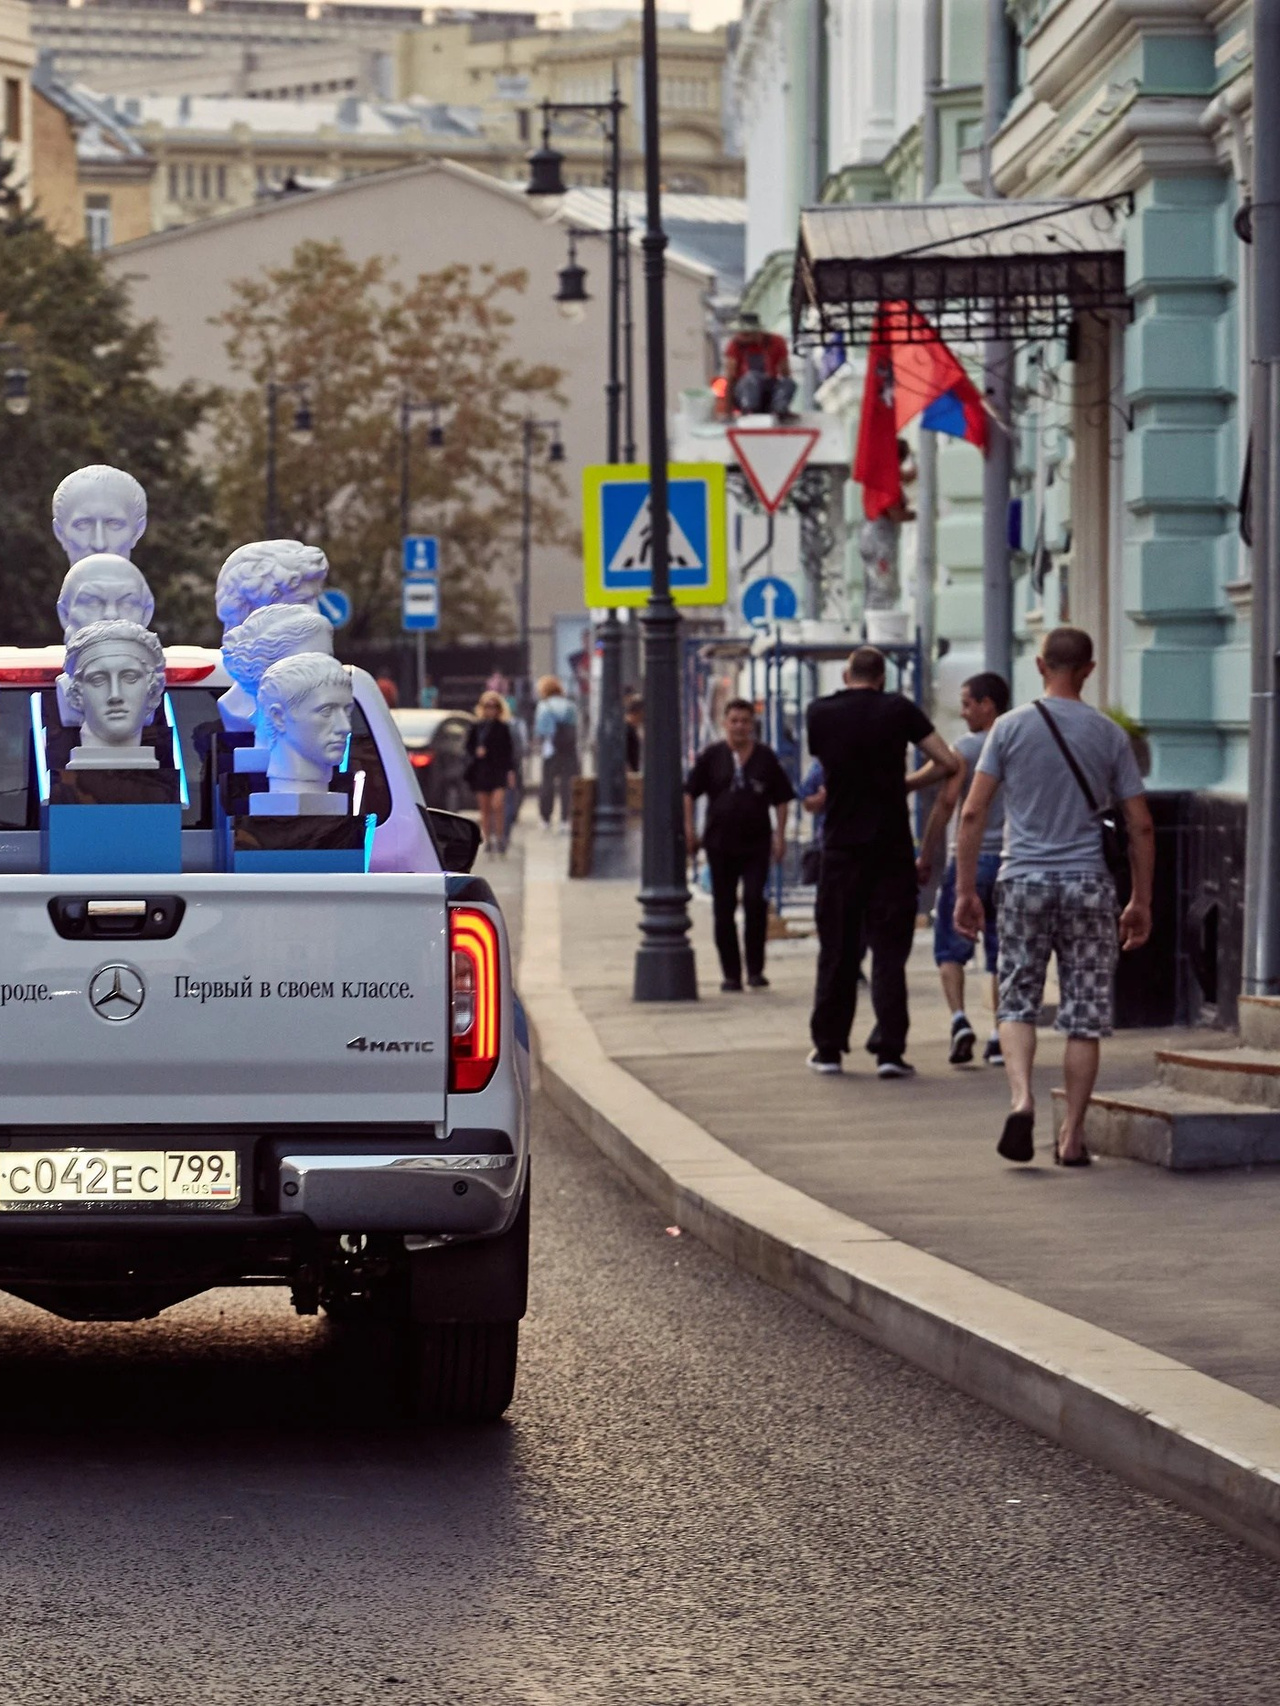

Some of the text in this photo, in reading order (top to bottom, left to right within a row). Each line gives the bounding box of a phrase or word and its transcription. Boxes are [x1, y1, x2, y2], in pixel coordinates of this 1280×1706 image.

[0, 983, 54, 1007] роде.
[174, 975, 414, 1004] Первый в своем классе.
[346, 1036, 435, 1053] 4MATIC
[168, 1154, 224, 1183] 799
[181, 1183, 210, 1195] RUS
